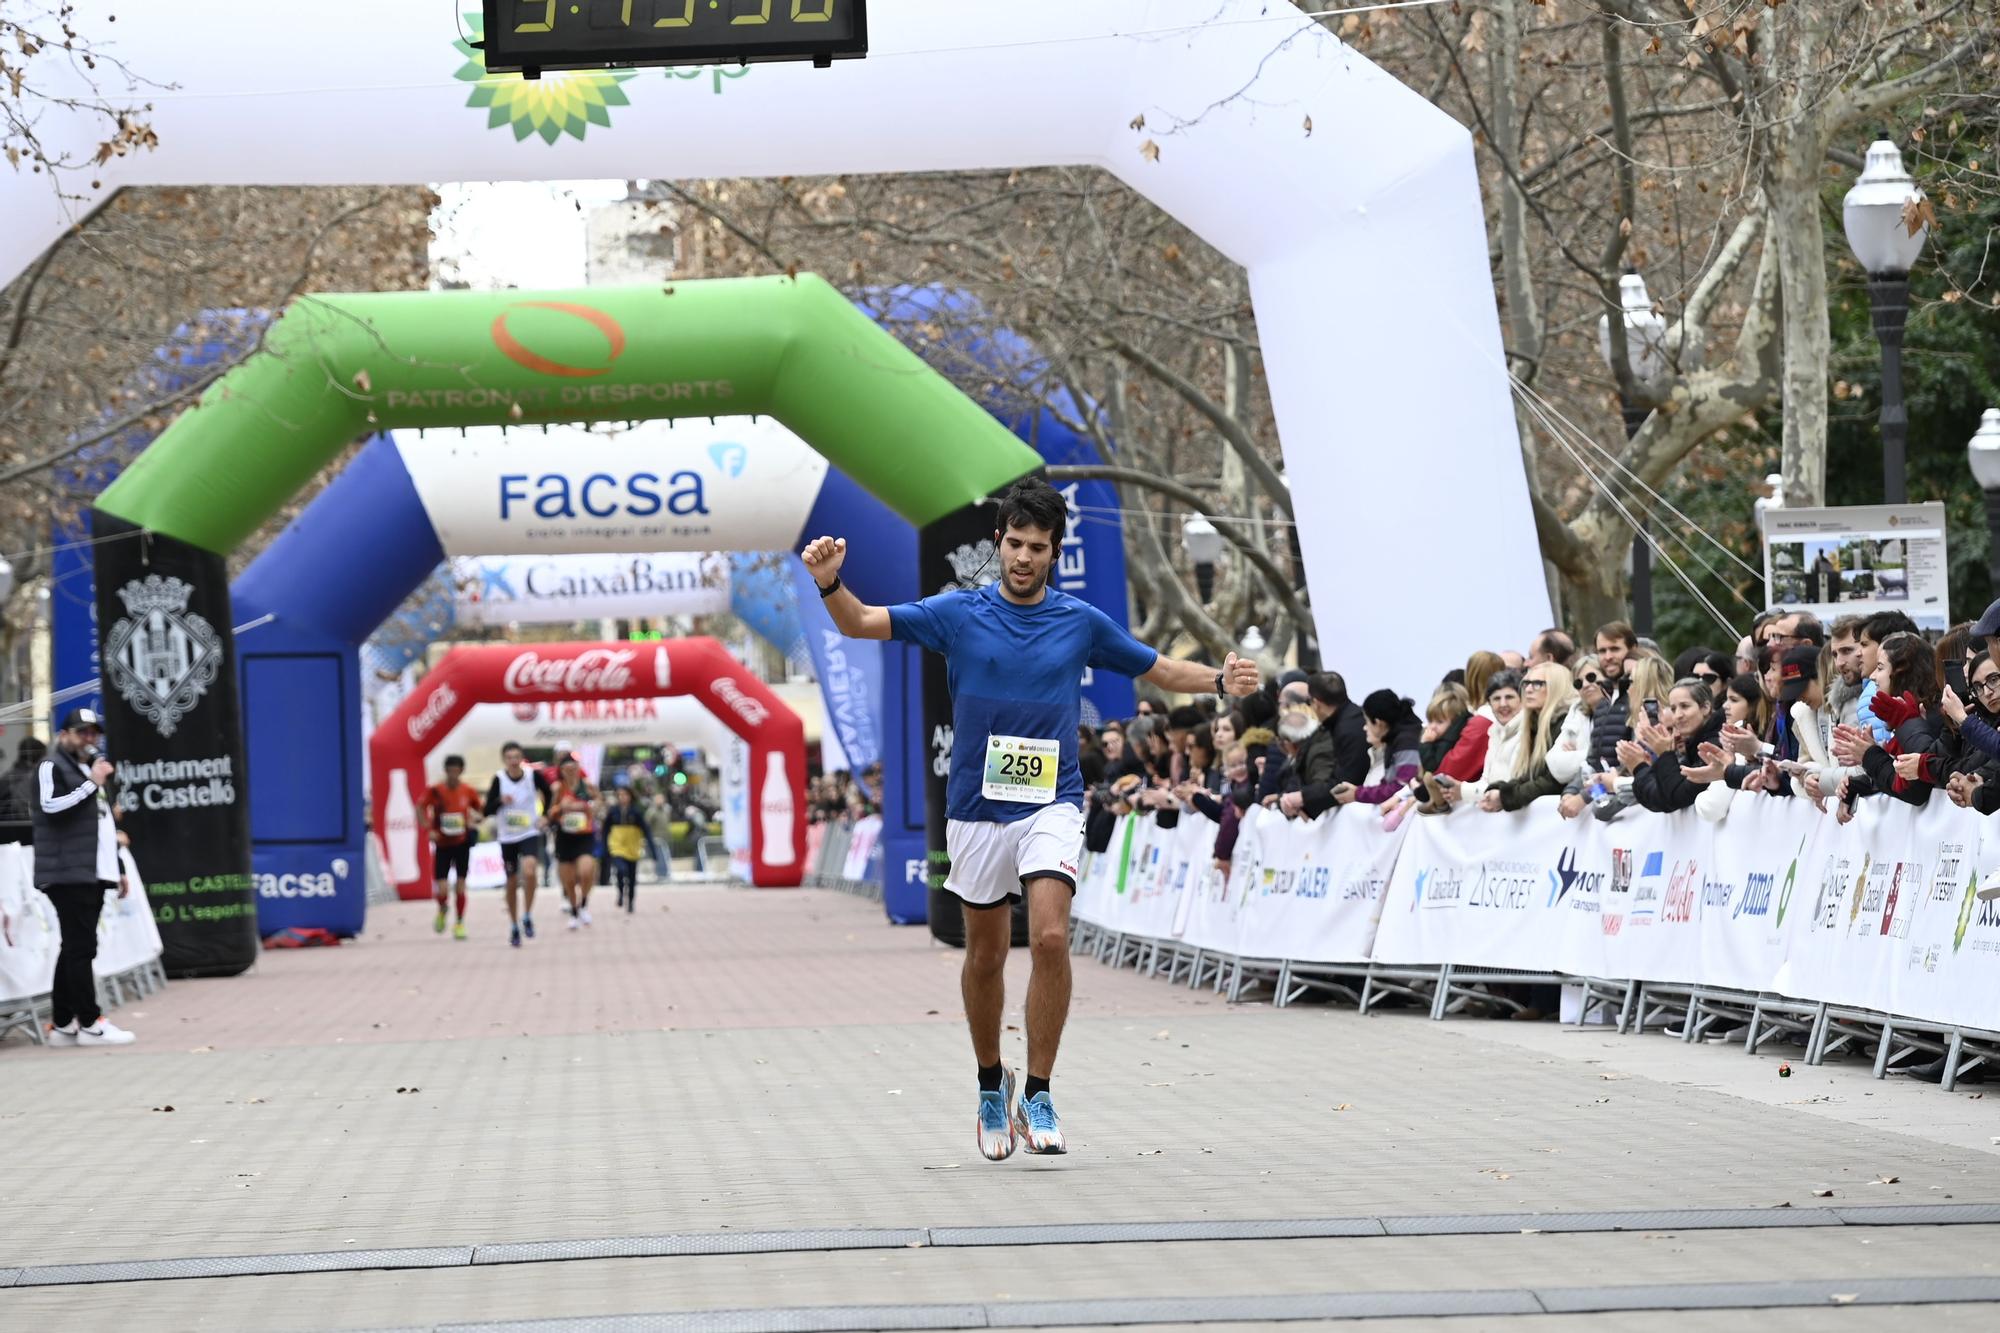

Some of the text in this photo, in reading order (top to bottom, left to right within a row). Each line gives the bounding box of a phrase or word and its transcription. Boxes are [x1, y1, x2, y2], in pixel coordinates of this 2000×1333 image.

[562, 380, 735, 402] D'ESPORTS
[671, 524, 712, 537] agua
[526, 558, 716, 599] CaixaBank
[114, 755, 233, 785] Ajuntament
[1000, 754, 1043, 777] 259
[1010, 776, 1031, 786] TONI
[143, 778, 236, 810] Castelló
